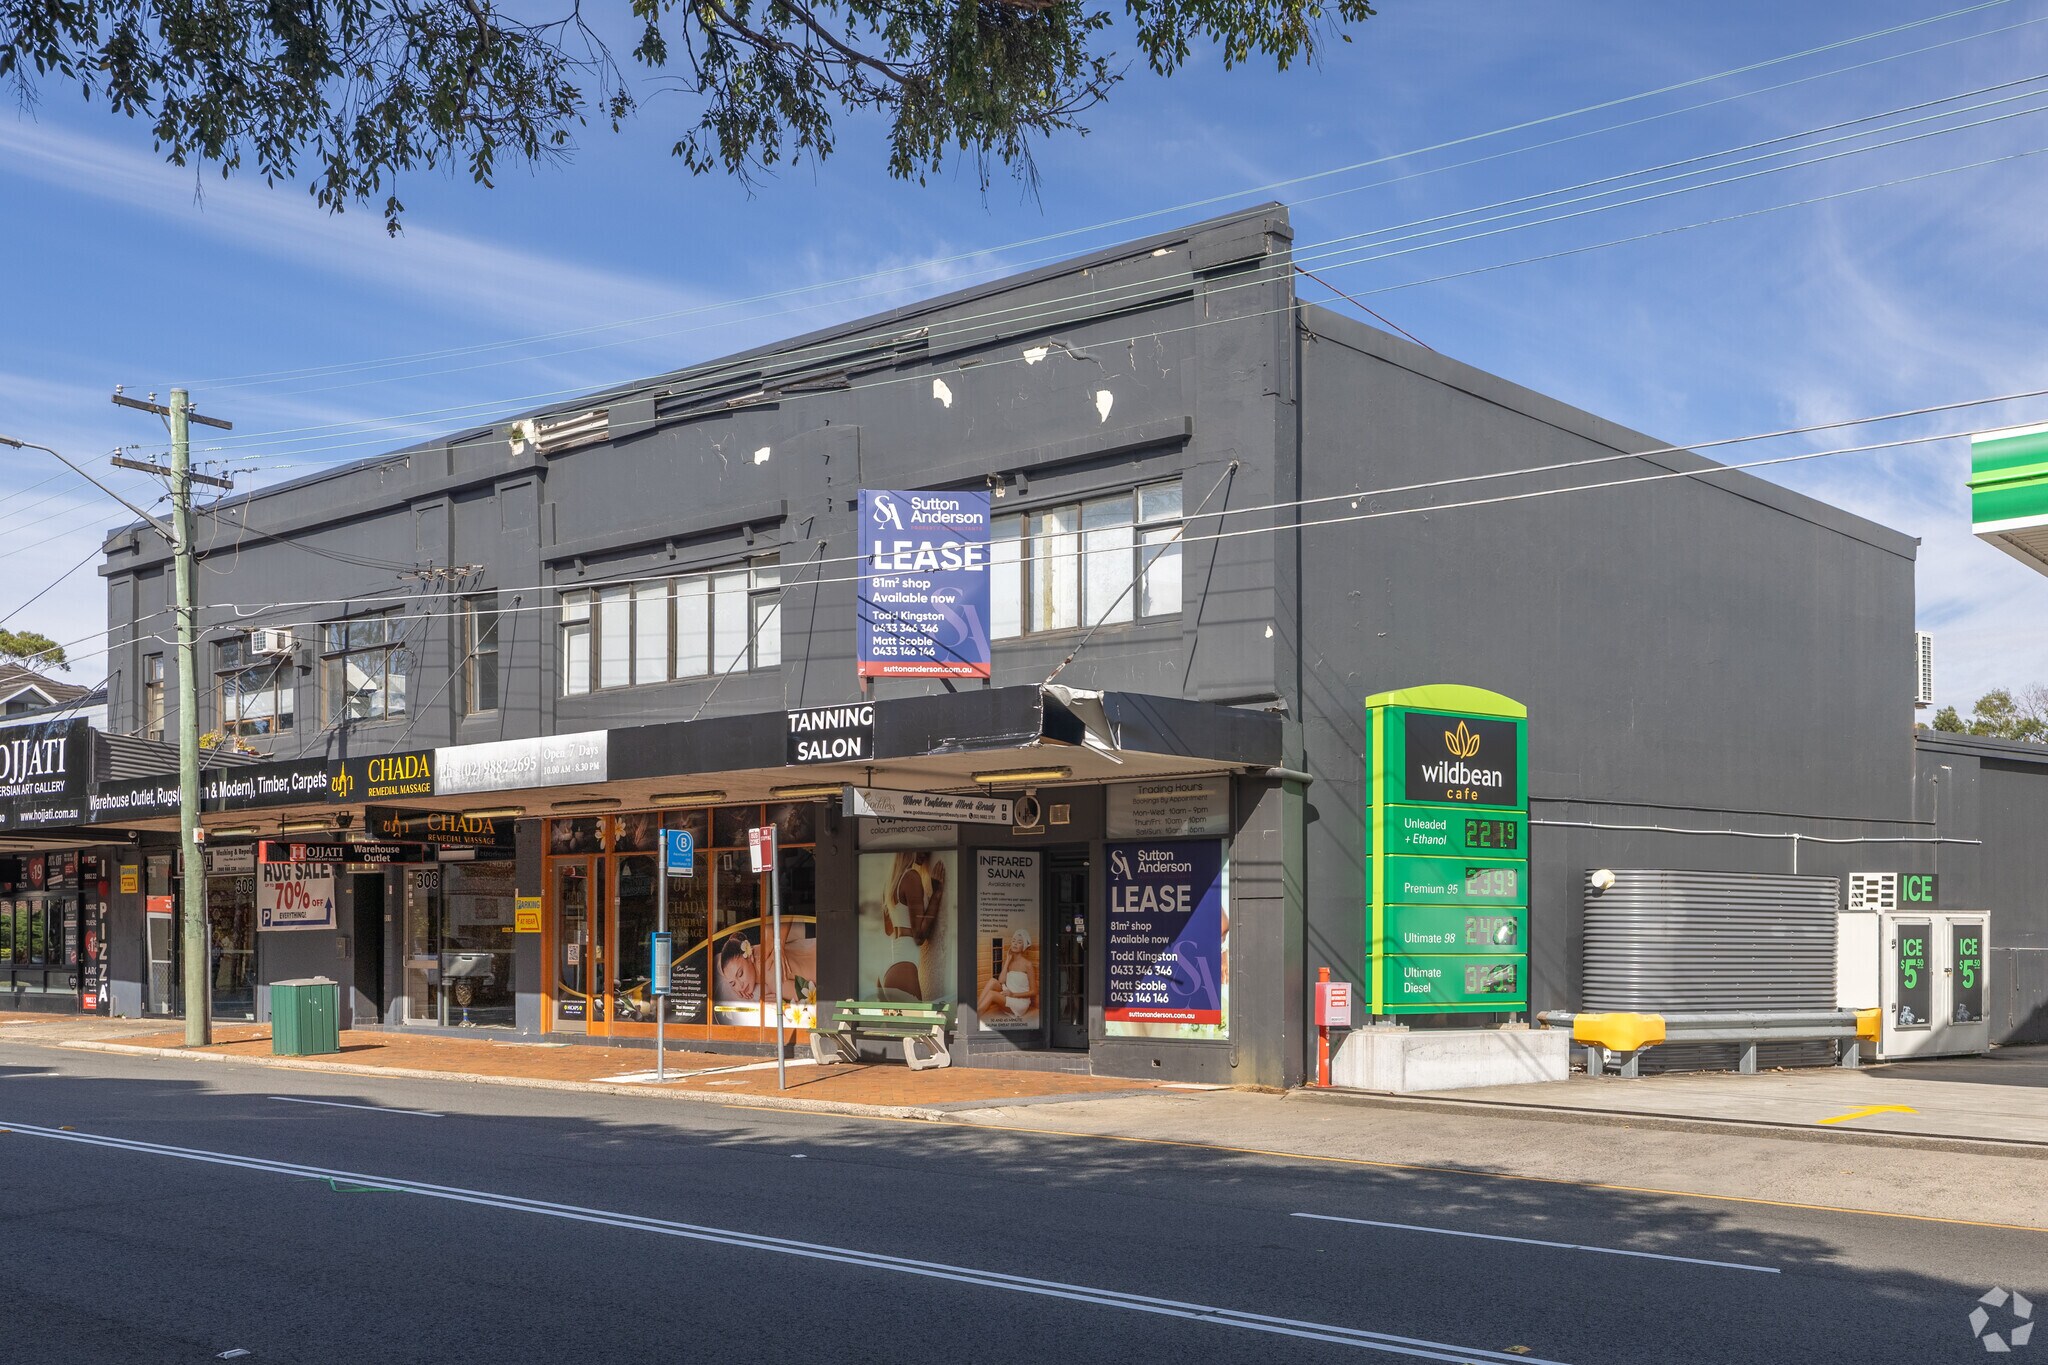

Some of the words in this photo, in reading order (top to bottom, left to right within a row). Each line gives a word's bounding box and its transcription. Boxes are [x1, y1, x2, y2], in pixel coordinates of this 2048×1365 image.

[911, 497, 960, 511] Sutton
[911, 511, 983, 524] Anderson
[874, 540, 984, 571] LEASE
[902, 579, 931, 590] shop
[872, 592, 928, 604] Available
[930, 595, 955, 604] now
[872, 611, 899, 621] Todd
[900, 611, 945, 624] Kingston
[872, 623, 898, 633] 0433
[899, 623, 918, 634] 346
[920, 624, 939, 634] 346
[872, 636, 897, 646] Matt
[899, 637, 933, 646] Scoble
[872, 647, 898, 656] 0433
[899, 647, 917, 657] 146
[919, 647, 936, 657] 146
[883, 665, 973, 674] suttonanderson.com.au
[788, 705, 874, 733] TANNING
[543, 747, 565, 762] Open
[568, 743, 575, 758] 7
[578, 744, 599, 759] Days
[797, 737, 861, 761] SALON
[368, 753, 431, 783] CHADA
[460, 762, 481, 780] (02)
[483, 760, 508, 775] 9882
[512, 756, 537, 773] 2695
[543, 765, 560, 776] 10.00
[560, 763, 571, 774] AM
[575, 762, 588, 773] 8.30
[589, 760, 600, 772] PM
[1422, 762, 1502, 788] wildbean
[21, 783, 33, 795] ART
[34, 780, 66, 794] GALLERY
[90, 793, 129, 810] Warehouse
[130, 788, 155, 807] Outlet,
[211, 782, 217, 798] &
[219, 777, 255, 799] Modern),
[257, 775, 289, 796] Timber,
[291, 771, 327, 792] Carpets
[368, 784, 399, 797] REMEDIAL
[400, 782, 431, 794] MASSAGE
[1137, 784, 1173, 795] Trading
[1175, 782, 1203, 792] Hours
[1132, 797, 1159, 805] Bookings
[1160, 797, 1168, 805] By
[1169, 794, 1208, 803] Appointment
[1446, 787, 1479, 801] cafe
[861, 795, 896, 814] Goddess
[902, 795, 922, 807] Where
[924, 796, 953, 808] Confidence
[955, 799, 973, 811] Meets
[975, 800, 997, 813] Beauty
[20, 808, 79, 822] www.hojjati.com.au
[1168, 807, 1187, 815] 10am
[1193, 806, 1209, 814] 9pm
[427, 813, 496, 835] CHADA
[1164, 817, 1182, 825] 10am
[1188, 816, 1206, 824] 10pm
[1404, 818, 1447, 830] Unleaded
[870, 824, 952, 835] colourmebronze.com.au
[1189, 826, 1205, 834] 6pm
[427, 834, 458, 843] REMEDIAL
[459, 836, 496, 845] MASSAGE
[680, 837, 688, 848] B
[1412, 833, 1447, 845] Ethanol
[216, 849, 233, 857] Washing
[291, 846, 344, 860] HOJJATI
[353, 844, 400, 854] Warehouse
[363, 854, 391, 863] Outlet
[980, 855, 1033, 867] INFRARED
[1137, 849, 1174, 862] Sutton
[31, 863, 43, 880] $19
[264, 863, 291, 882] RUG
[295, 862, 330, 880] SALE
[1137, 861, 1191, 873] Anderson
[987, 868, 1025, 879] SAUNA
[236, 878, 254, 893] 308
[416, 872, 438, 889] 308
[275, 880, 310, 909] 70%
[1404, 883, 1445, 895] Premium
[1446, 884, 1458, 895] 95
[1902, 875, 1933, 902] ICE
[312, 899, 324, 907] OFF
[517, 900, 540, 909] PARKING
[1111, 885, 1191, 913] LEASE
[667, 901, 706, 914] CHADA
[279, 911, 307, 919] EVERYTHING!
[1131, 921, 1152, 933] shop
[1110, 934, 1150, 944] Available
[1151, 936, 1169, 944] now
[1404, 932, 1442, 944] Ultimate
[1444, 933, 1456, 944] 98
[1903, 938, 1923, 956] ICE
[1959, 938, 1978, 955] ICE
[1110, 951, 1135, 961] Todd
[1136, 951, 1178, 963] Kingston
[1110, 965, 1134, 975] 0433
[1135, 965, 1153, 976] 346
[1155, 965, 1172, 976] 346
[1404, 967, 1442, 978] Ultimate
[1110, 980, 1133, 990] Matt
[1135, 980, 1167, 991] Scoble
[1404, 981, 1431, 993] Diesel
[1110, 993, 1134, 1003] 0433
[1135, 993, 1152, 1003] 146
[1153, 993, 1169, 1003] 146
[1128, 1011, 1195, 1019] suttonanderson.com.au
